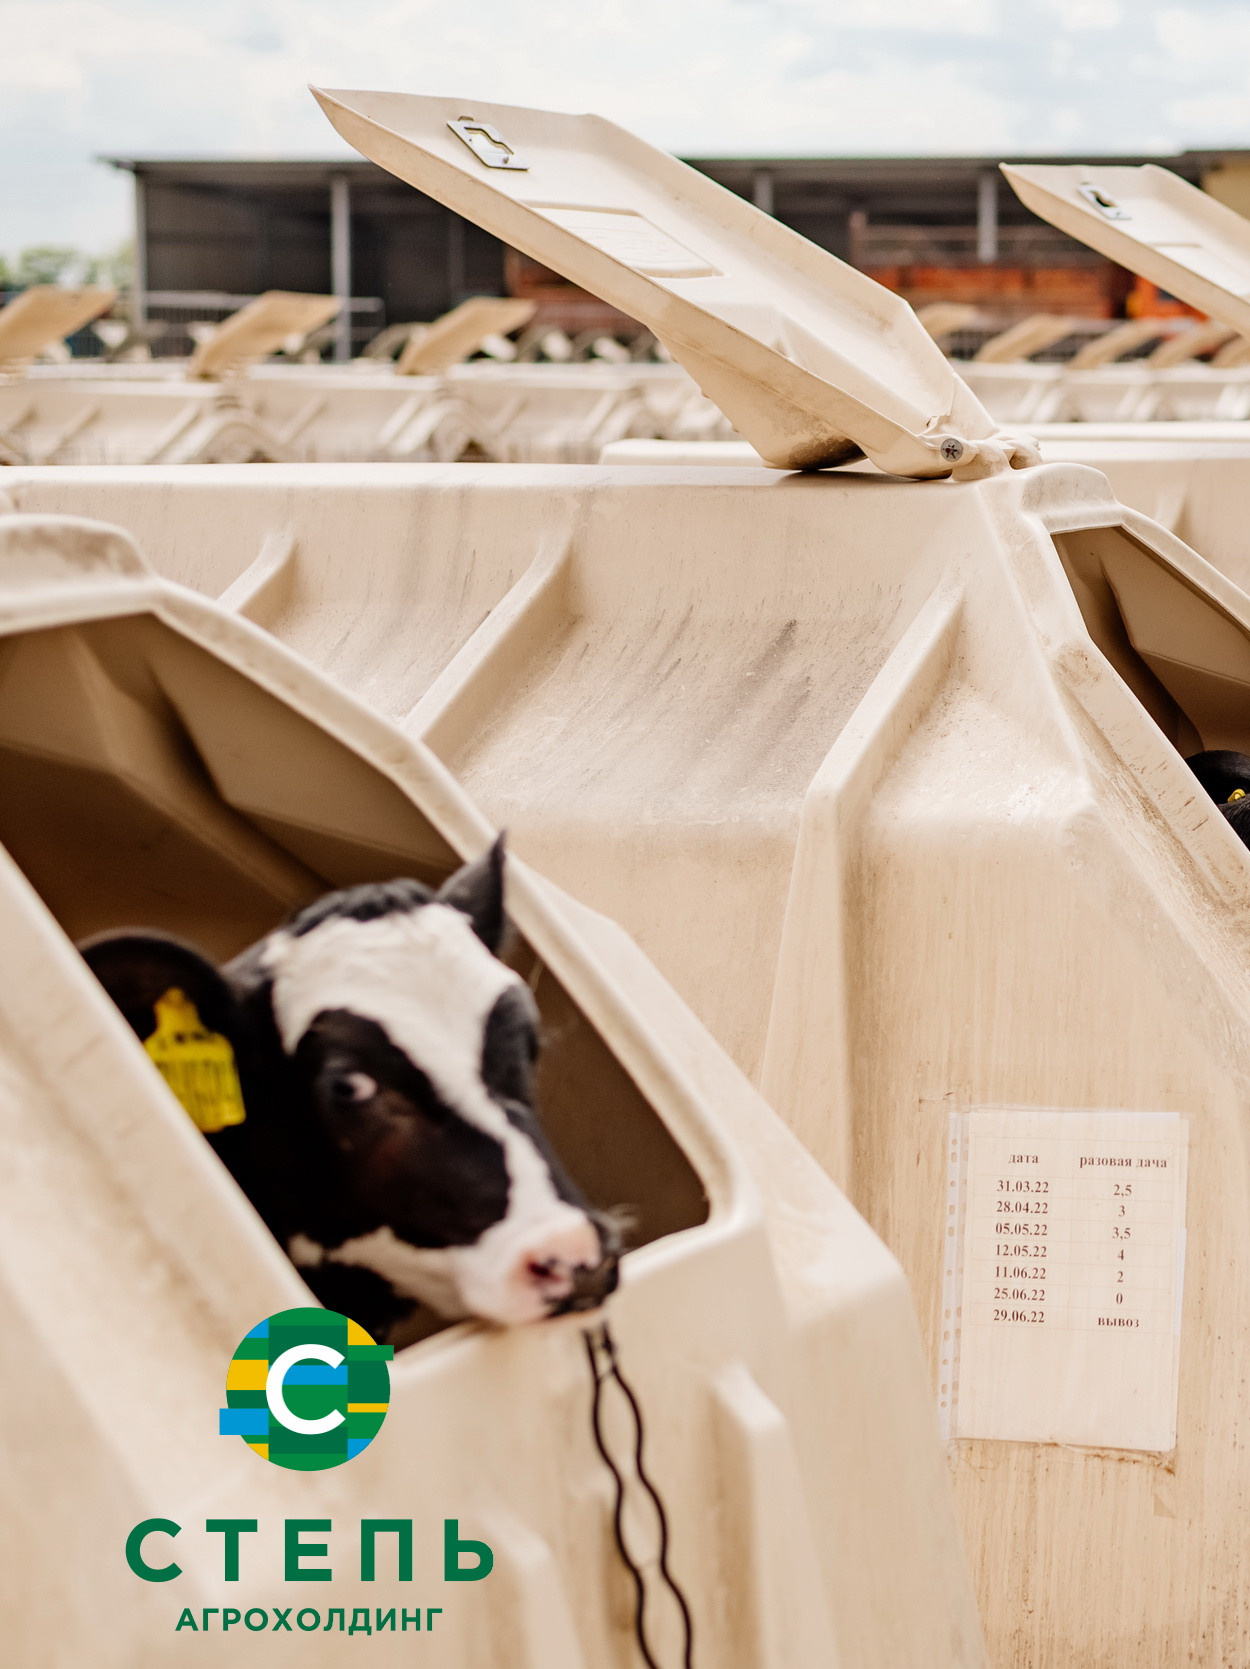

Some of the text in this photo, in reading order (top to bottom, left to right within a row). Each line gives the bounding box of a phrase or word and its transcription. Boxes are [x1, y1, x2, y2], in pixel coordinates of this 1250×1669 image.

[1008, 1153, 1039, 1164] дата
[1079, 1156, 1167, 1169] разовая дача
[997, 1180, 1049, 1193] 31.03.22
[1113, 1184, 1132, 1197] 2,5
[996, 1201, 1048, 1214] 28.04.22
[1118, 1205, 1126, 1217] 3
[995, 1222, 1048, 1236] 05.05.22
[1112, 1227, 1131, 1240] 3,5
[995, 1244, 1047, 1258] 12.05.22
[1117, 1249, 1125, 1261] 4
[995, 1266, 1046, 1280] 11.06.22
[1117, 1271, 1124, 1283] 2
[994, 1287, 1045, 1301] 25.06.22
[1115, 1292, 1123, 1304] 0
[993, 1309, 1045, 1323] 29.06.22
[1098, 1317, 1140, 1328] вывоз
